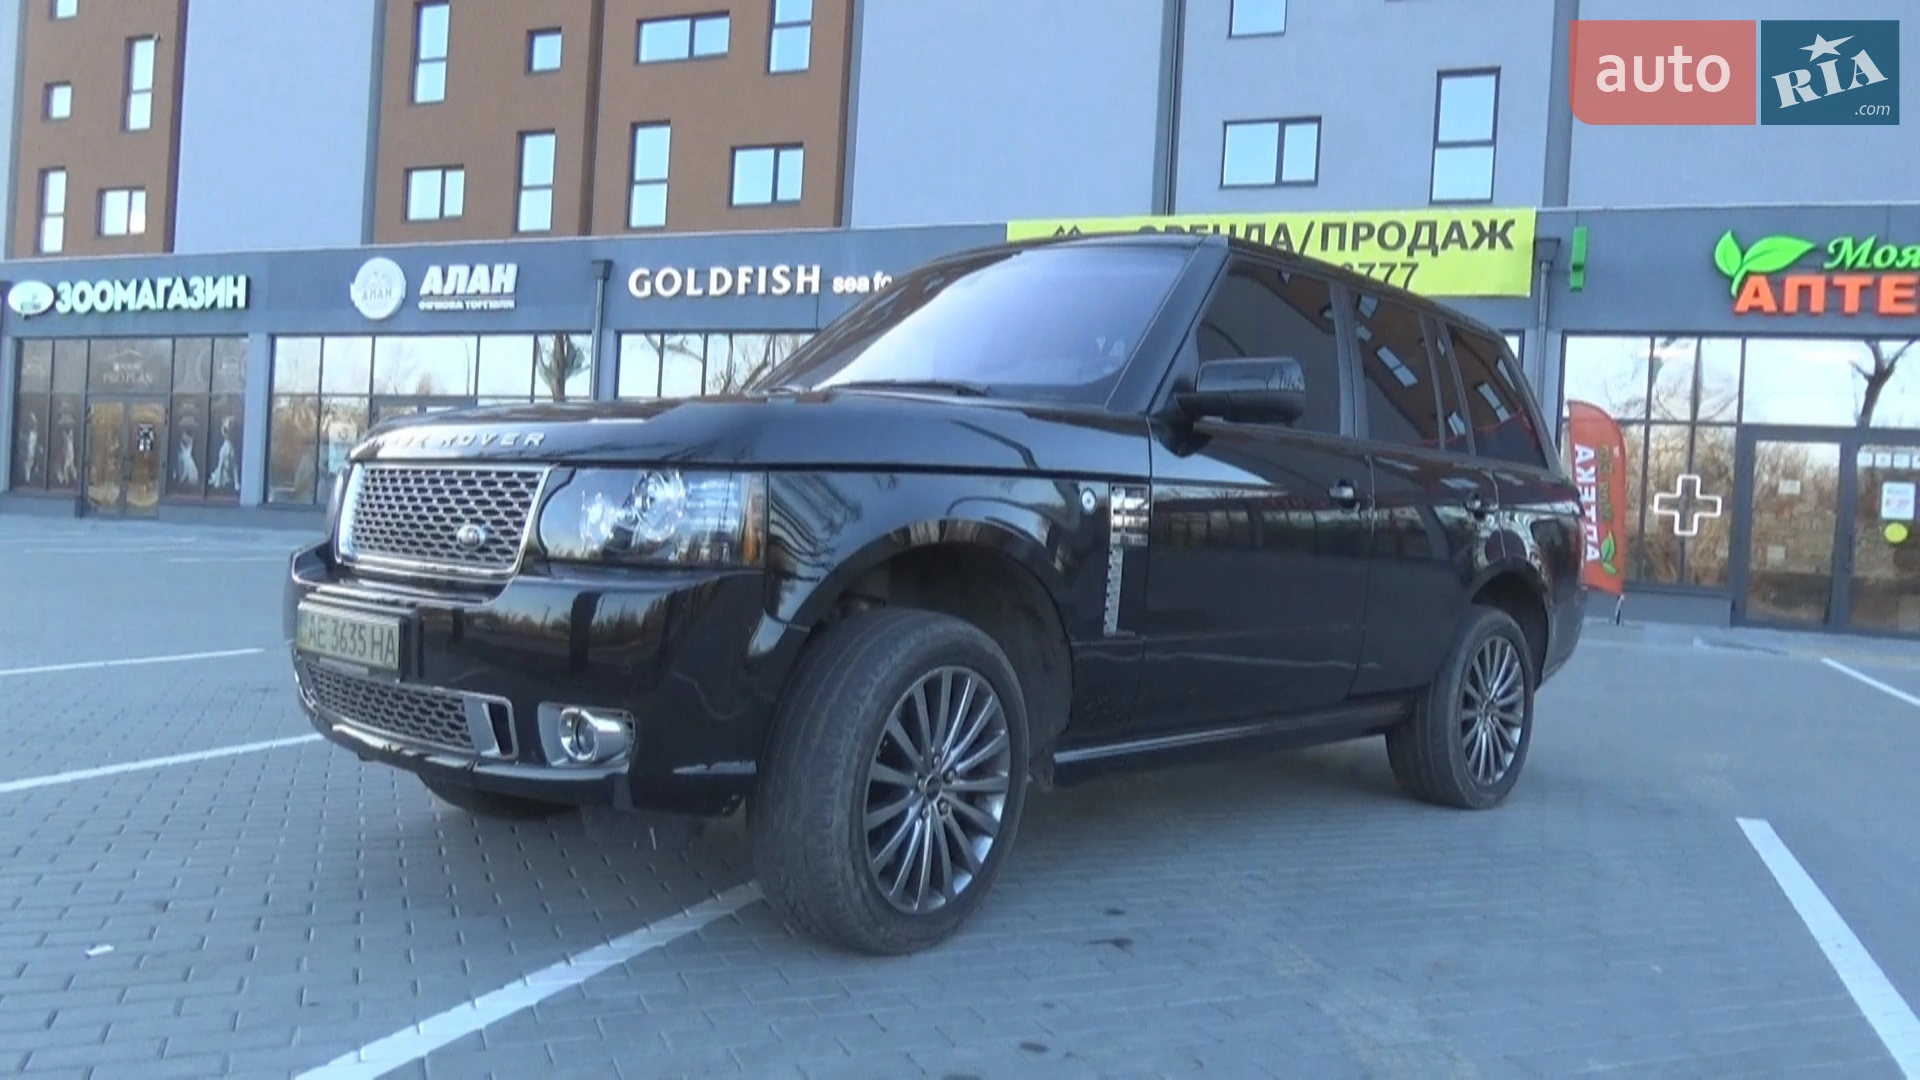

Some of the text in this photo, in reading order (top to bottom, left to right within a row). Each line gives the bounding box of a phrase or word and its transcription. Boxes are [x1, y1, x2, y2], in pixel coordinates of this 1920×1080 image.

[1137, 219, 1516, 258] ДА/ПРОДАЖ
[1823, 234, 1920, 270] Моя
[55, 274, 248, 314] ЗООМАГАЗИН
[418, 263, 519, 296] АЛАН
[627, 264, 821, 298] GOLDFISH
[832, 275, 870, 293] sea
[1734, 273, 1919, 314] АПТЕ
[308, 614, 397, 666] AE 3635 HA
